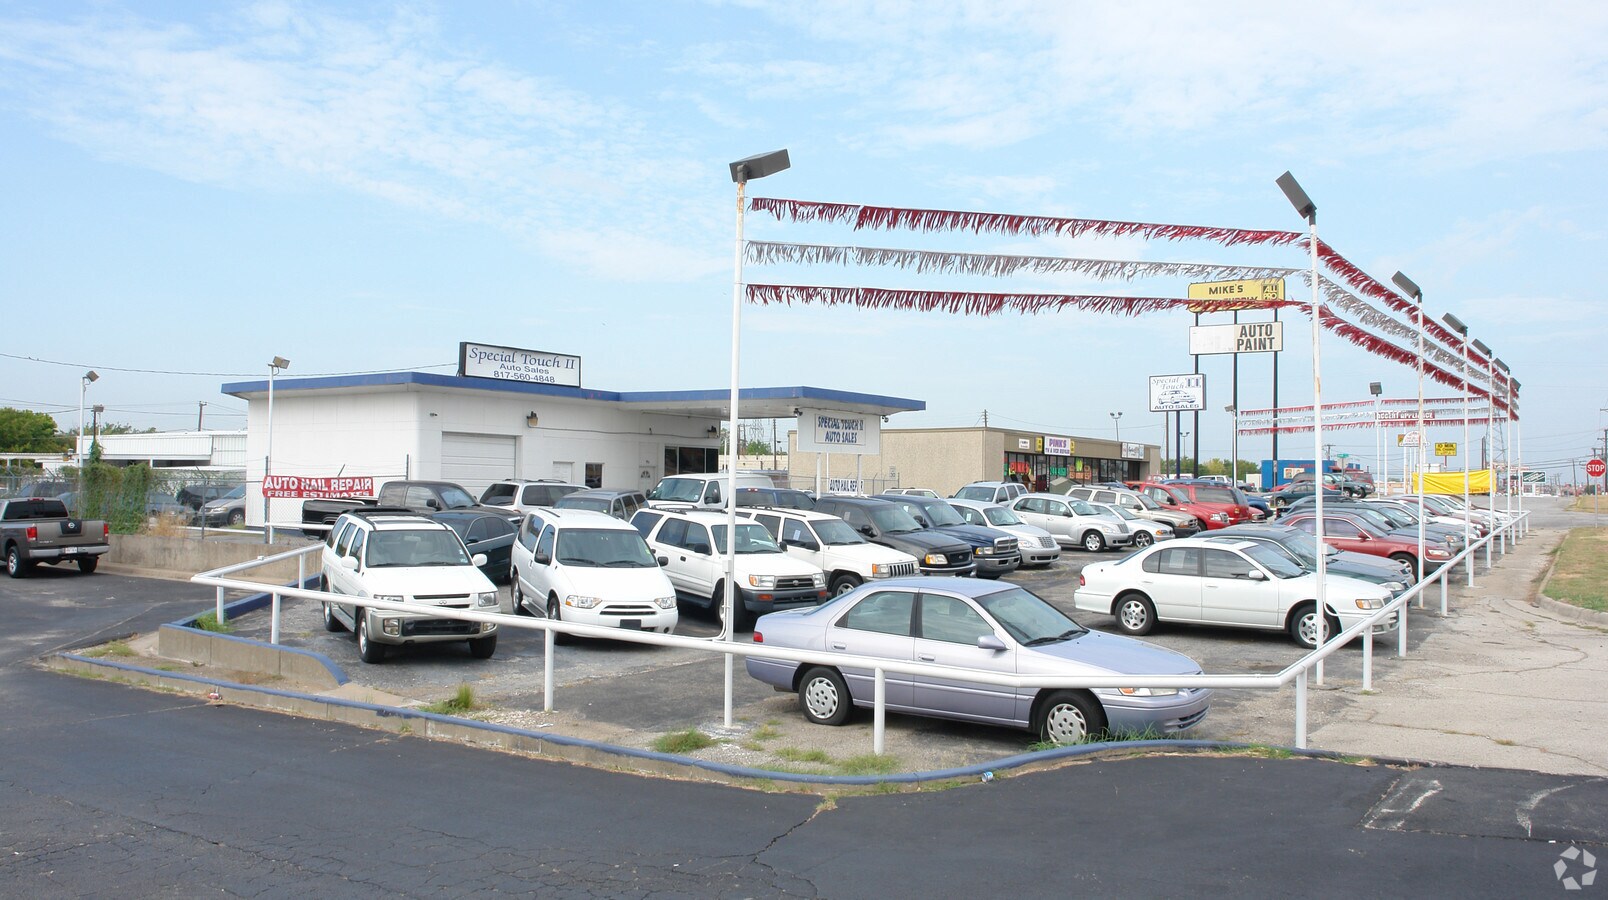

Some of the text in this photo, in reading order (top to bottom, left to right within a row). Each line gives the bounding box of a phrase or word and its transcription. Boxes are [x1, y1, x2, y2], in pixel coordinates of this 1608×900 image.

[1208, 284, 1244, 295] MIKE'S
[1239, 323, 1273, 338] AUTO
[1236, 337, 1275, 351] PAINT
[469, 347, 575, 369] Special Touch II
[500, 363, 549, 375] Auto Sales
[493, 370, 555, 383] 817-560-4848
[1151, 377, 1180, 386] Special
[1160, 381, 1184, 390] Touch
[817, 415, 840, 430] SPECIAL
[841, 418, 859, 431] TOUCH
[824, 430, 858, 444] AUTO SALES
[264, 476, 372, 491] AUTO HAIL REPAIR
[830, 479, 841, 491] AUTO
[267, 490, 370, 499] FREE ESTIMATES
